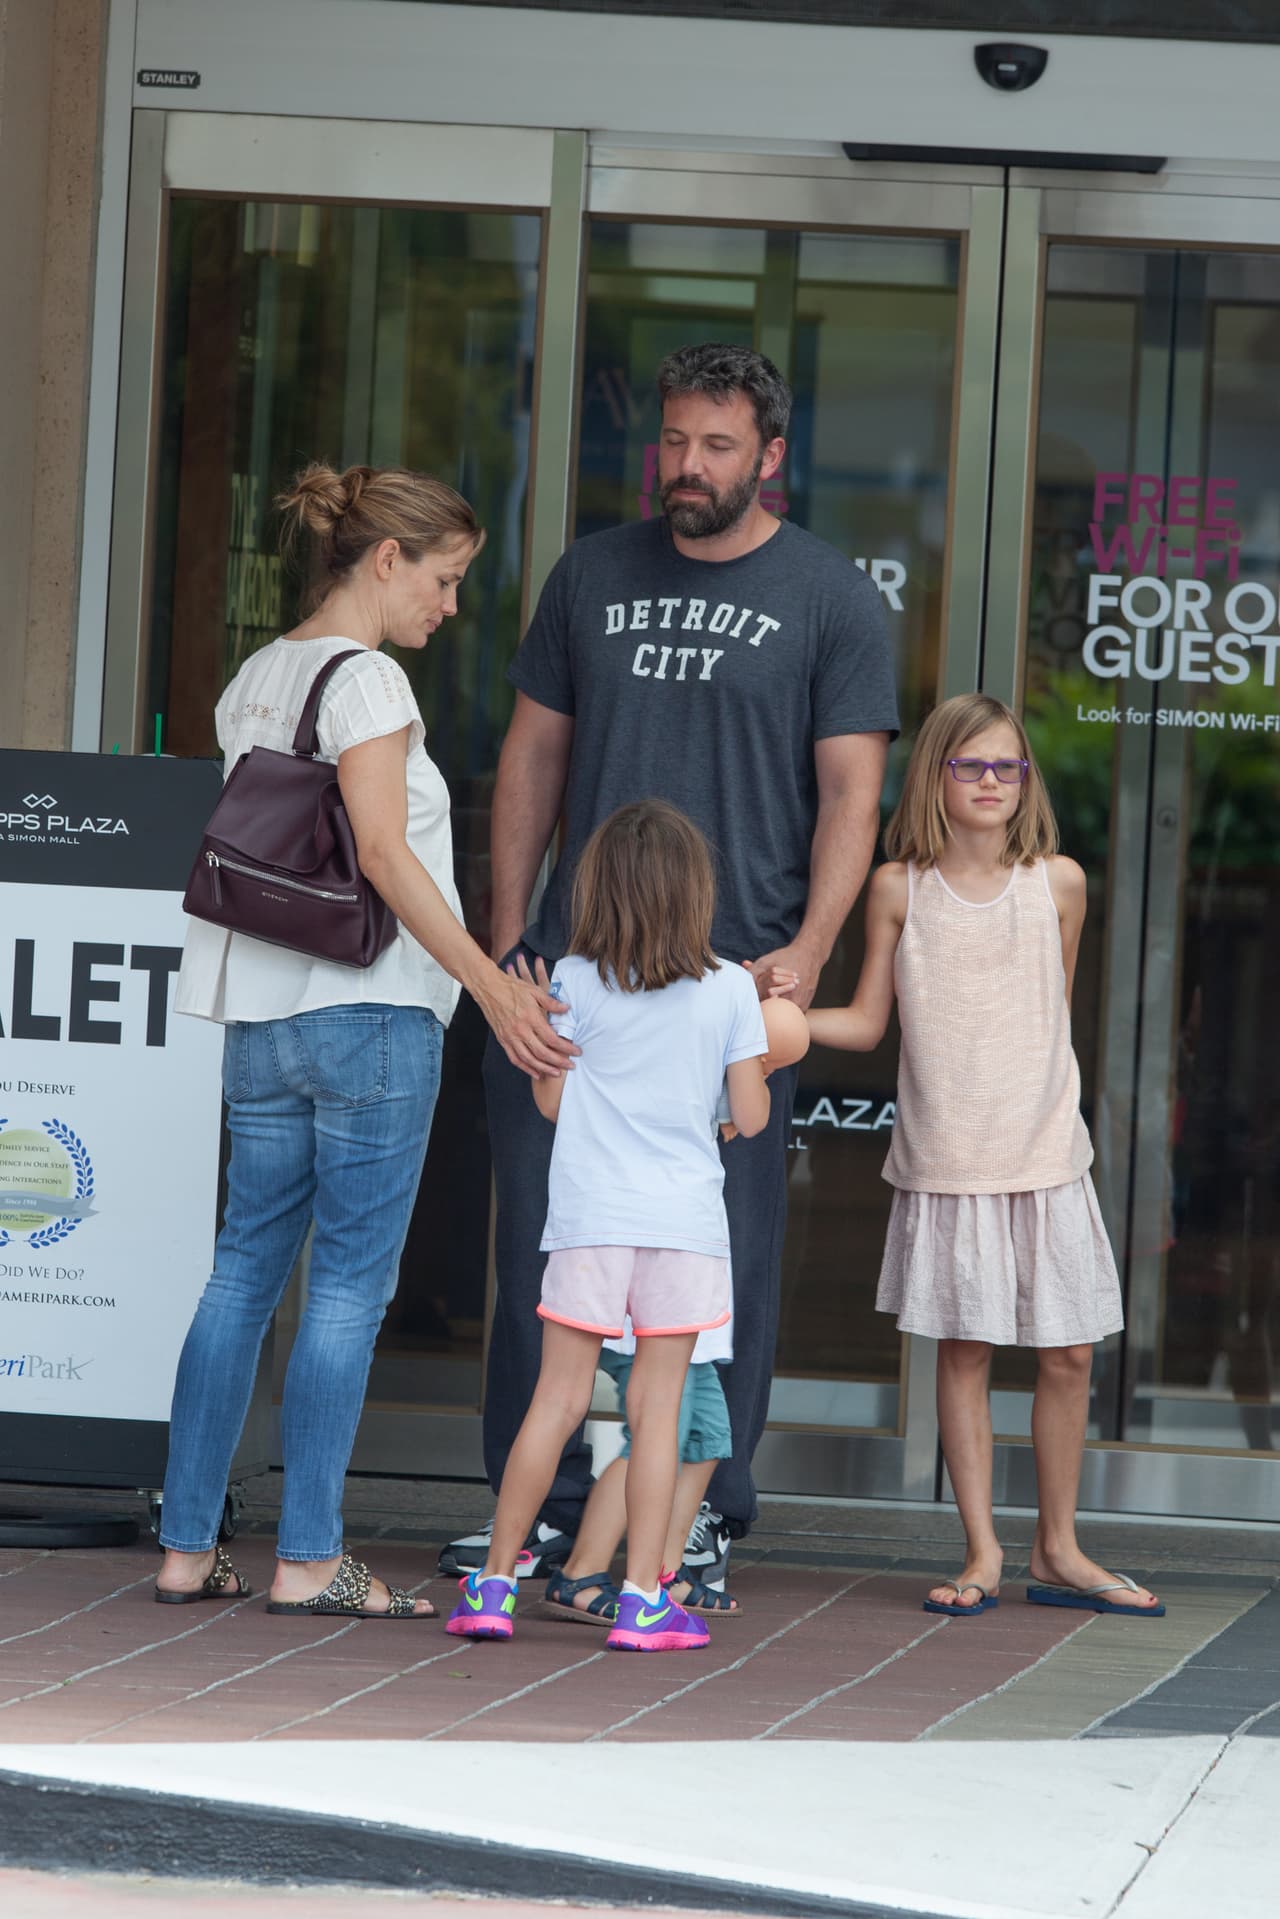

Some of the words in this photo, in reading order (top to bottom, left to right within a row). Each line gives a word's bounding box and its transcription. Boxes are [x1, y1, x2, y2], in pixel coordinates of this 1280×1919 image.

[142, 71, 197, 85] STANLEY
[1093, 472, 1238, 529] FREE
[1088, 522, 1242, 582] Wi-Fi
[1087, 574, 1213, 631] FOR
[1224, 582, 1280, 635] O
[605, 597, 782, 647] DETROIT
[631, 643, 725, 681] CITY
[1077, 704, 1122, 724] Look
[1126, 707, 1151, 725] for
[1156, 708, 1225, 729] SIMON
[1230, 713, 1280, 733] Wi-Fi
[47, 815, 130, 835] PLAZA
[8, 834, 46, 843] SIMON
[50, 836, 80, 845] MALL
[18, 1080, 77, 1096] DESERVE
[24, 1144, 50, 1153] SERVICE
[33, 1160, 49, 1169] OUR
[12, 1174, 63, 1186] INTERACTIONS
[28, 1265, 51, 1279] WE
[55, 1266, 85, 1281] DO?
[0, 1290, 116, 1308] AMERIPARK.COM
